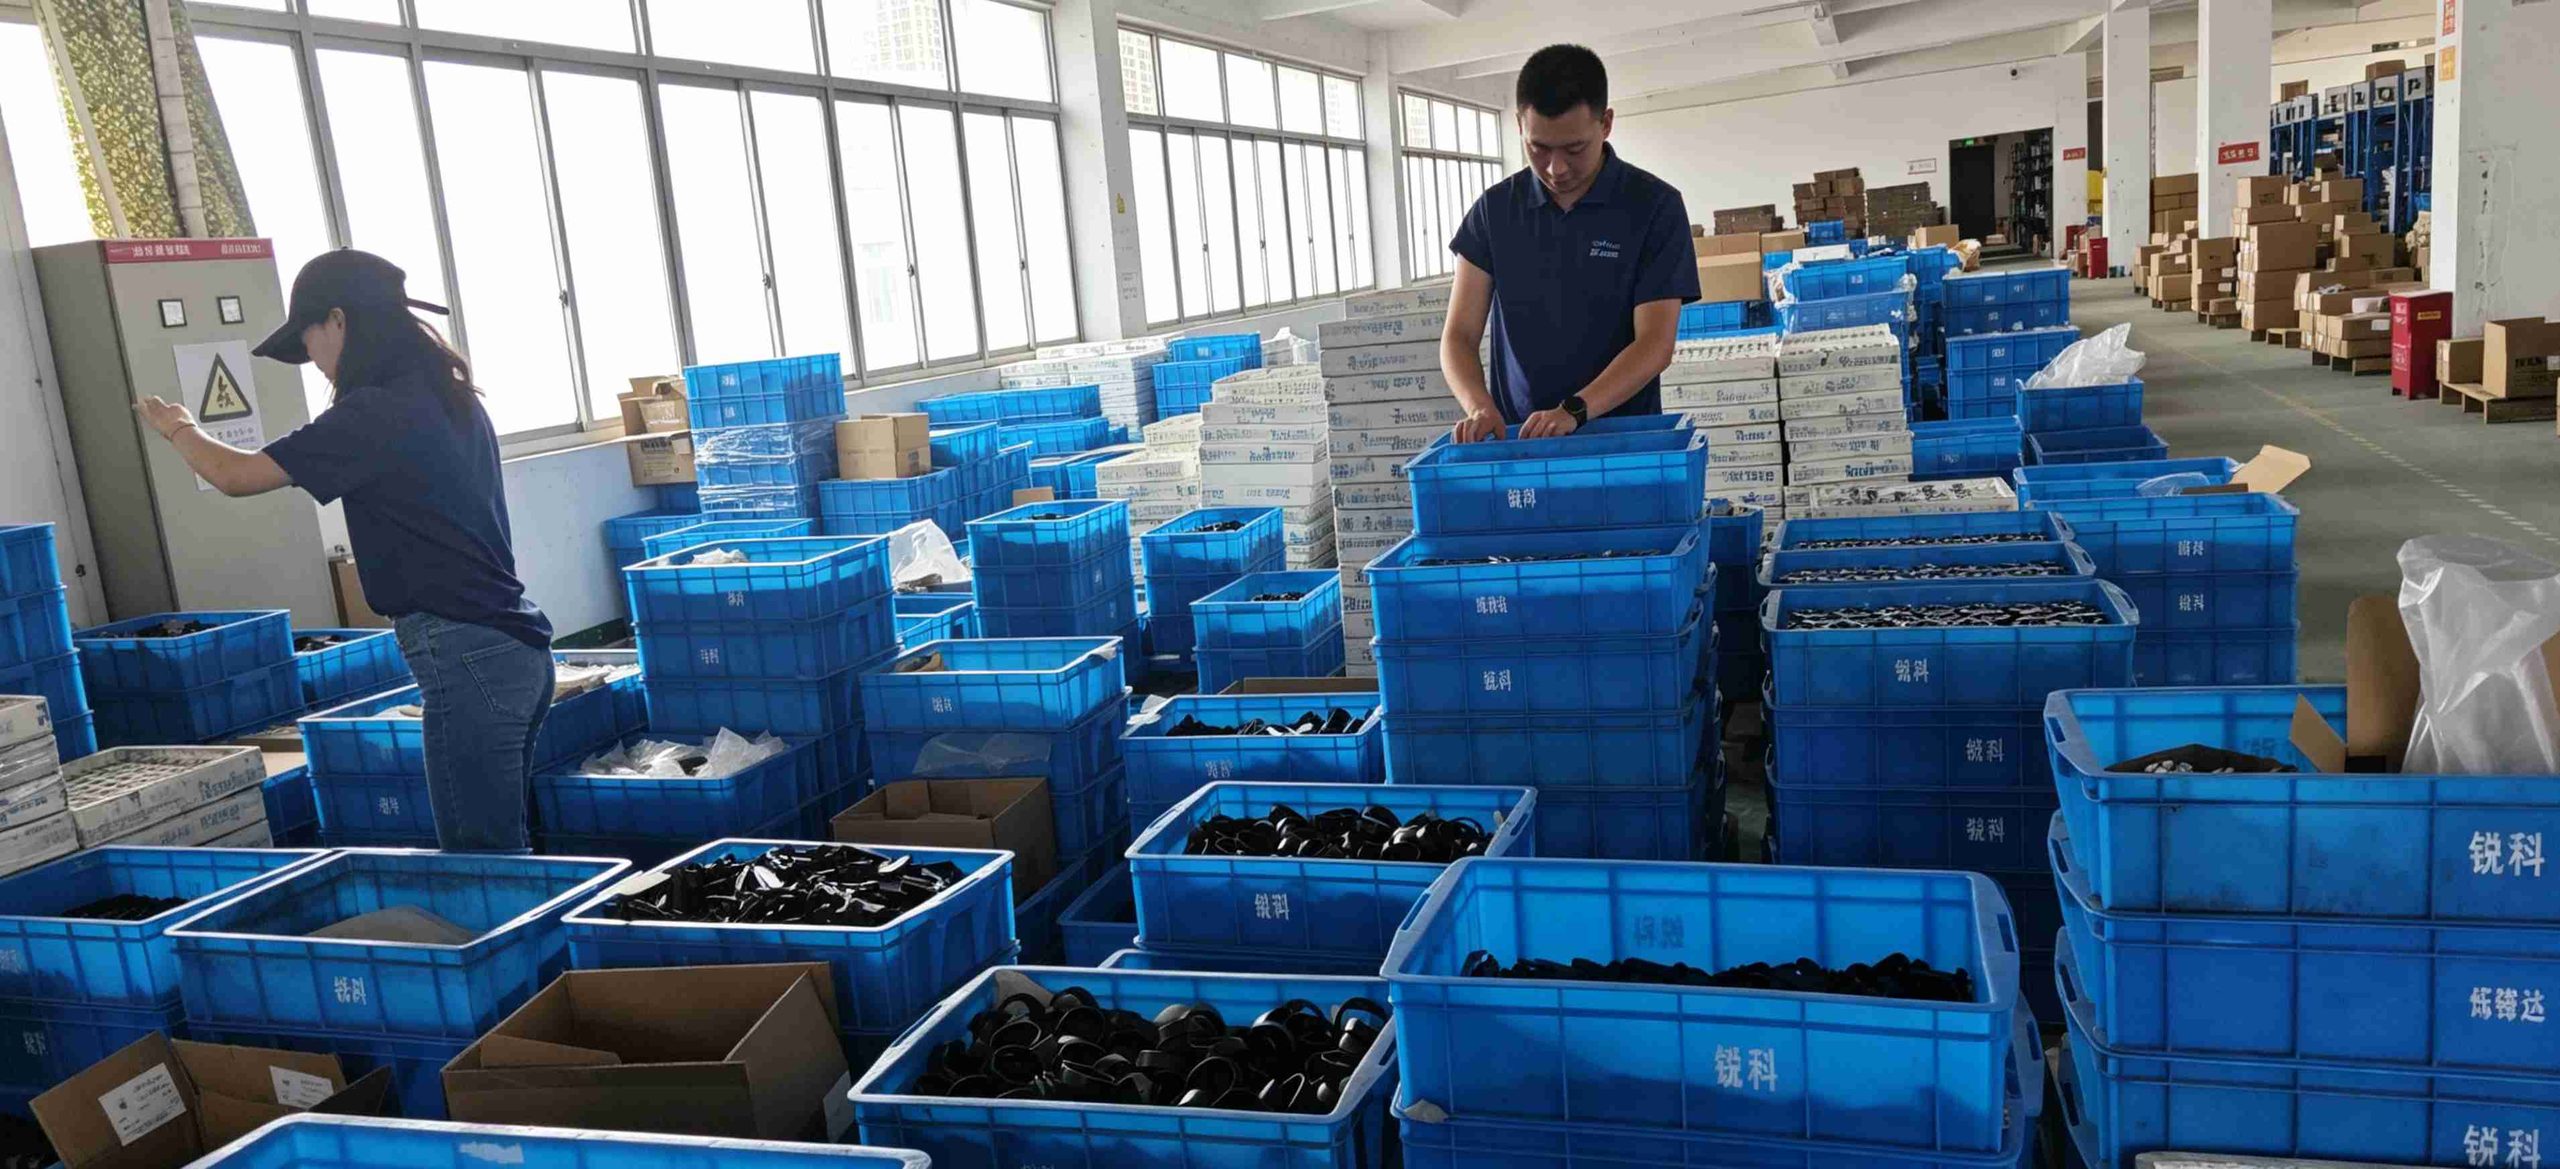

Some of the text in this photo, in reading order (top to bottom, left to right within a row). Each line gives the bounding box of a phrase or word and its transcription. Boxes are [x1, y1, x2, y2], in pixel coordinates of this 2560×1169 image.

[2468, 830, 2545, 877] 锐科
[1714, 1044, 1779, 1092] 锐科
[2463, 1124, 2541, 1169] 锐科
